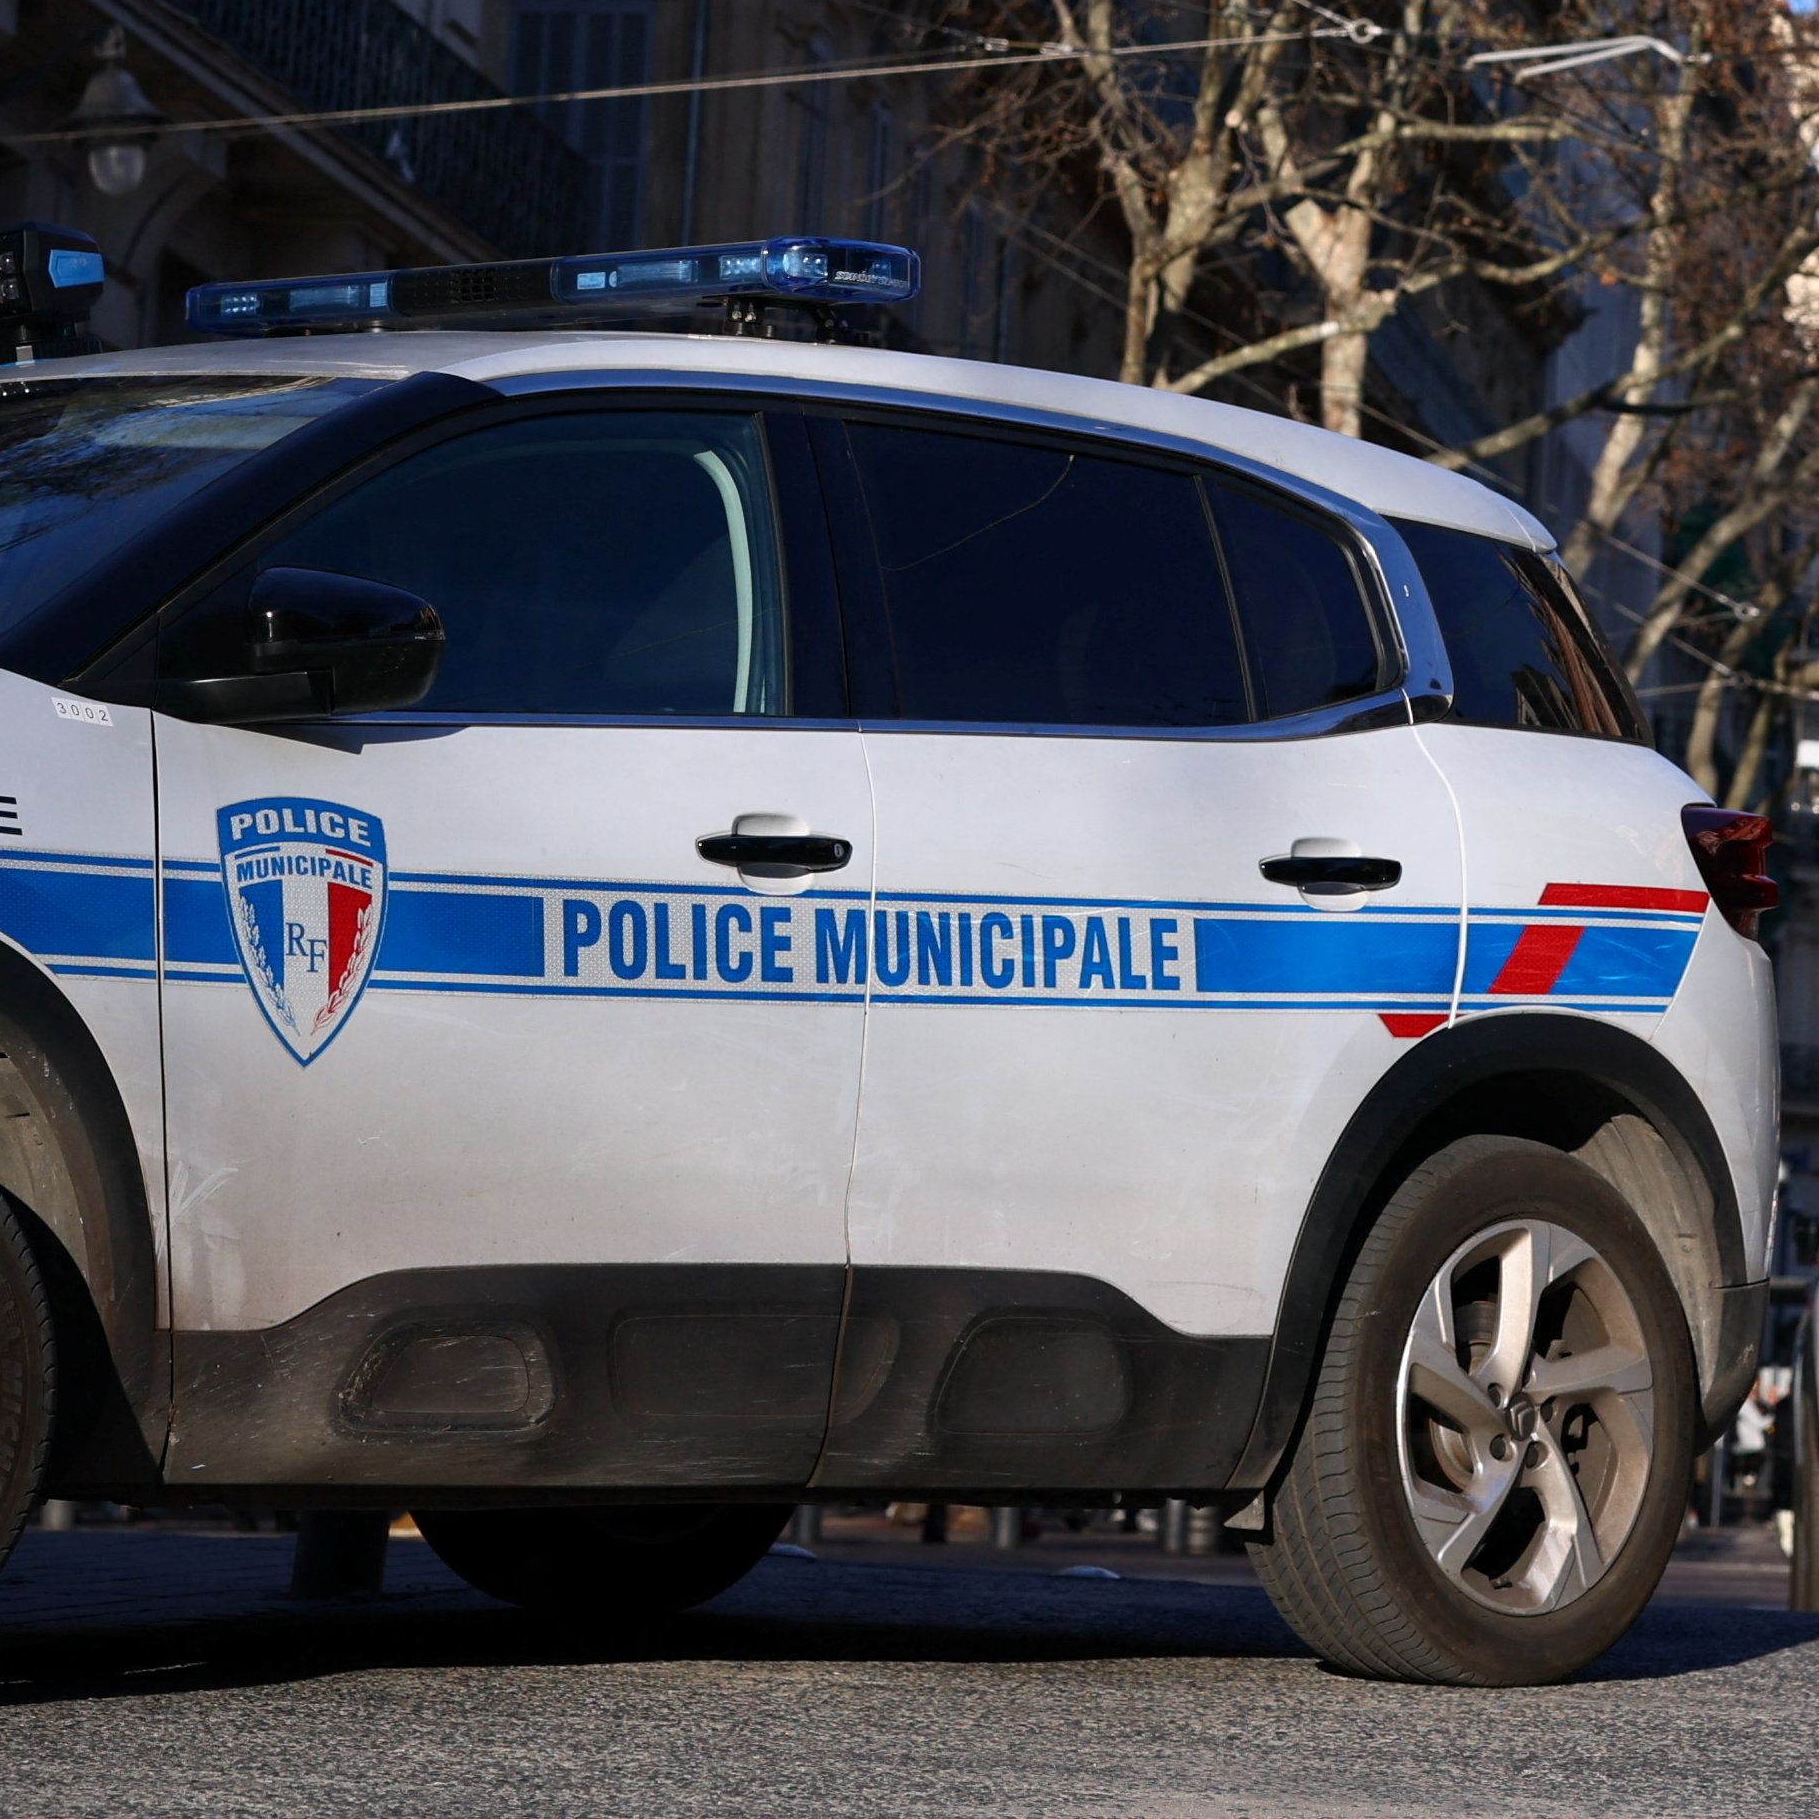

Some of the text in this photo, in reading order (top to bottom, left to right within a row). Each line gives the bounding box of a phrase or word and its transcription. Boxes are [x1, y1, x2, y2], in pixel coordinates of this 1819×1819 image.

[56, 702, 109, 722] 3002
[230, 808, 371, 848] POLICE
[236, 855, 372, 890] MUNICIPALE
[562, 897, 1181, 992] POLICE MUNICIPALE
